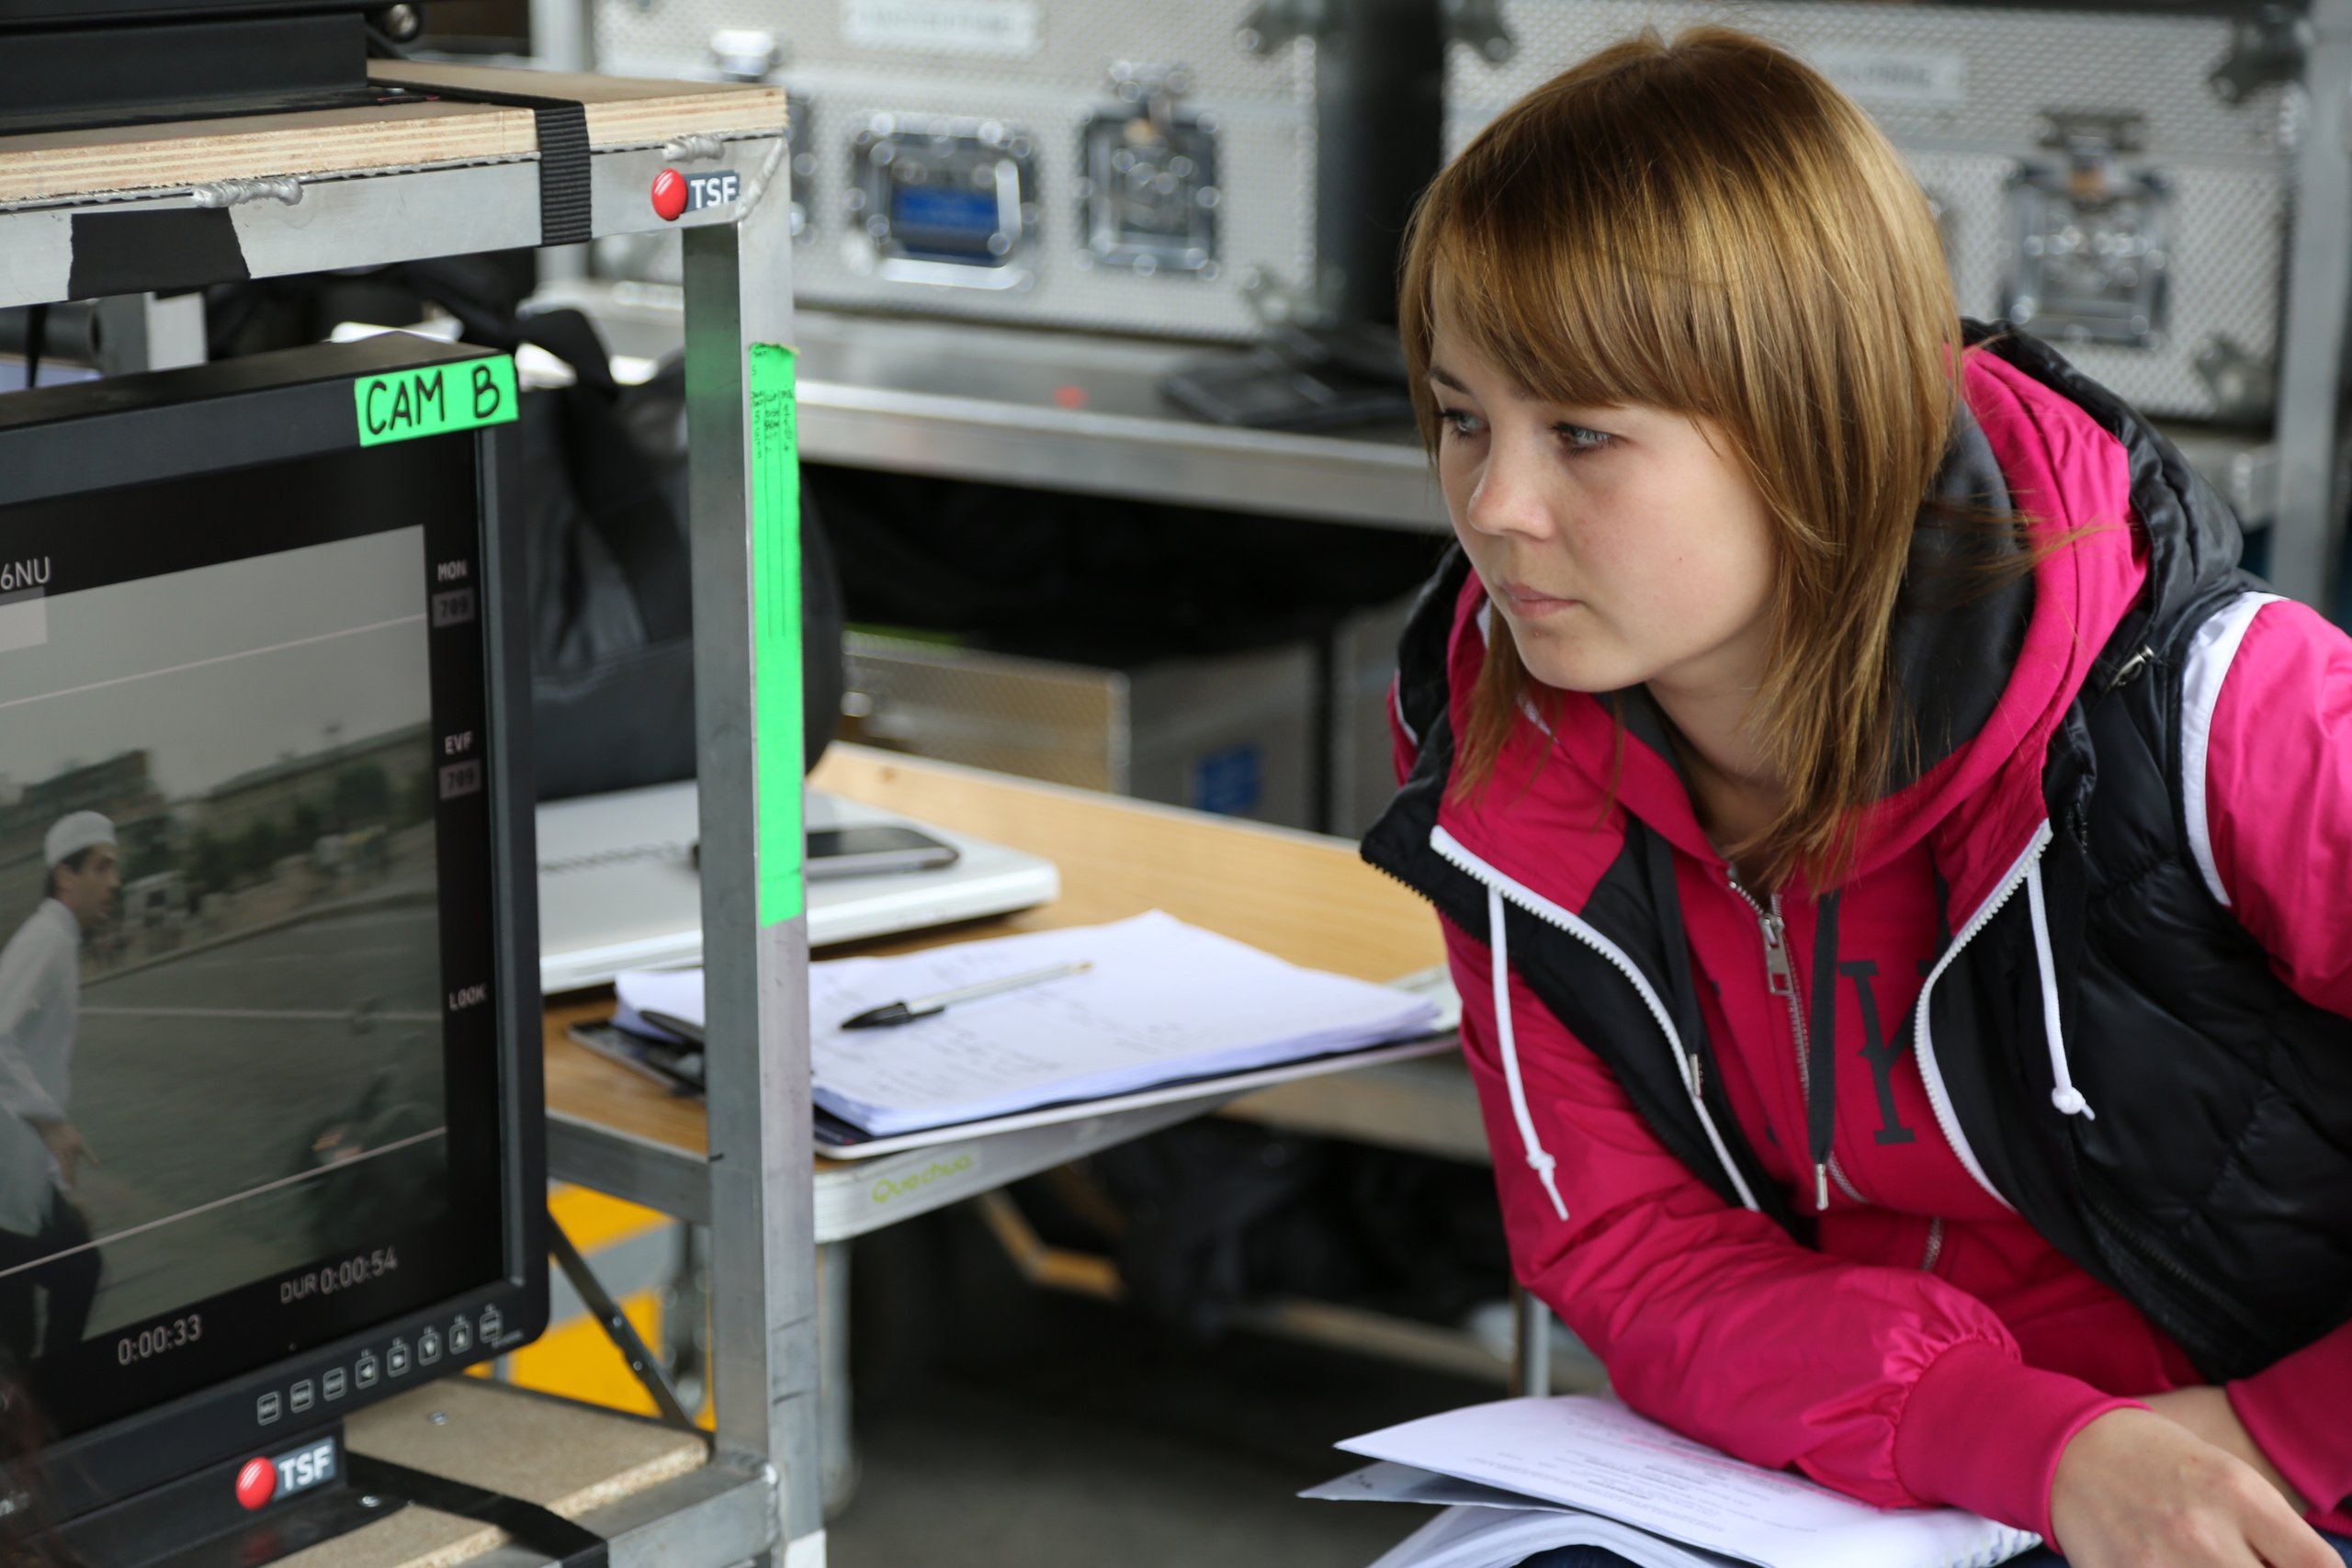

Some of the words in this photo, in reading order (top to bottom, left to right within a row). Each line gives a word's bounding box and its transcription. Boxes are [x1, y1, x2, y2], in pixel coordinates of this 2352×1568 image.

[690, 175, 737, 209] TSF
[367, 369, 445, 434] CAM
[471, 364, 500, 419] B
[0, 556, 51, 591] 6NU
[437, 558, 469, 581] MON
[439, 594, 469, 617] 709
[445, 730, 473, 755] EVF
[449, 983, 487, 1010] LOOK
[280, 1272, 319, 1304] DUR
[321, 1246, 398, 1295] 0:00:54
[118, 1314, 202, 1366] 0:00:33
[278, 1444, 331, 1492] TSF
